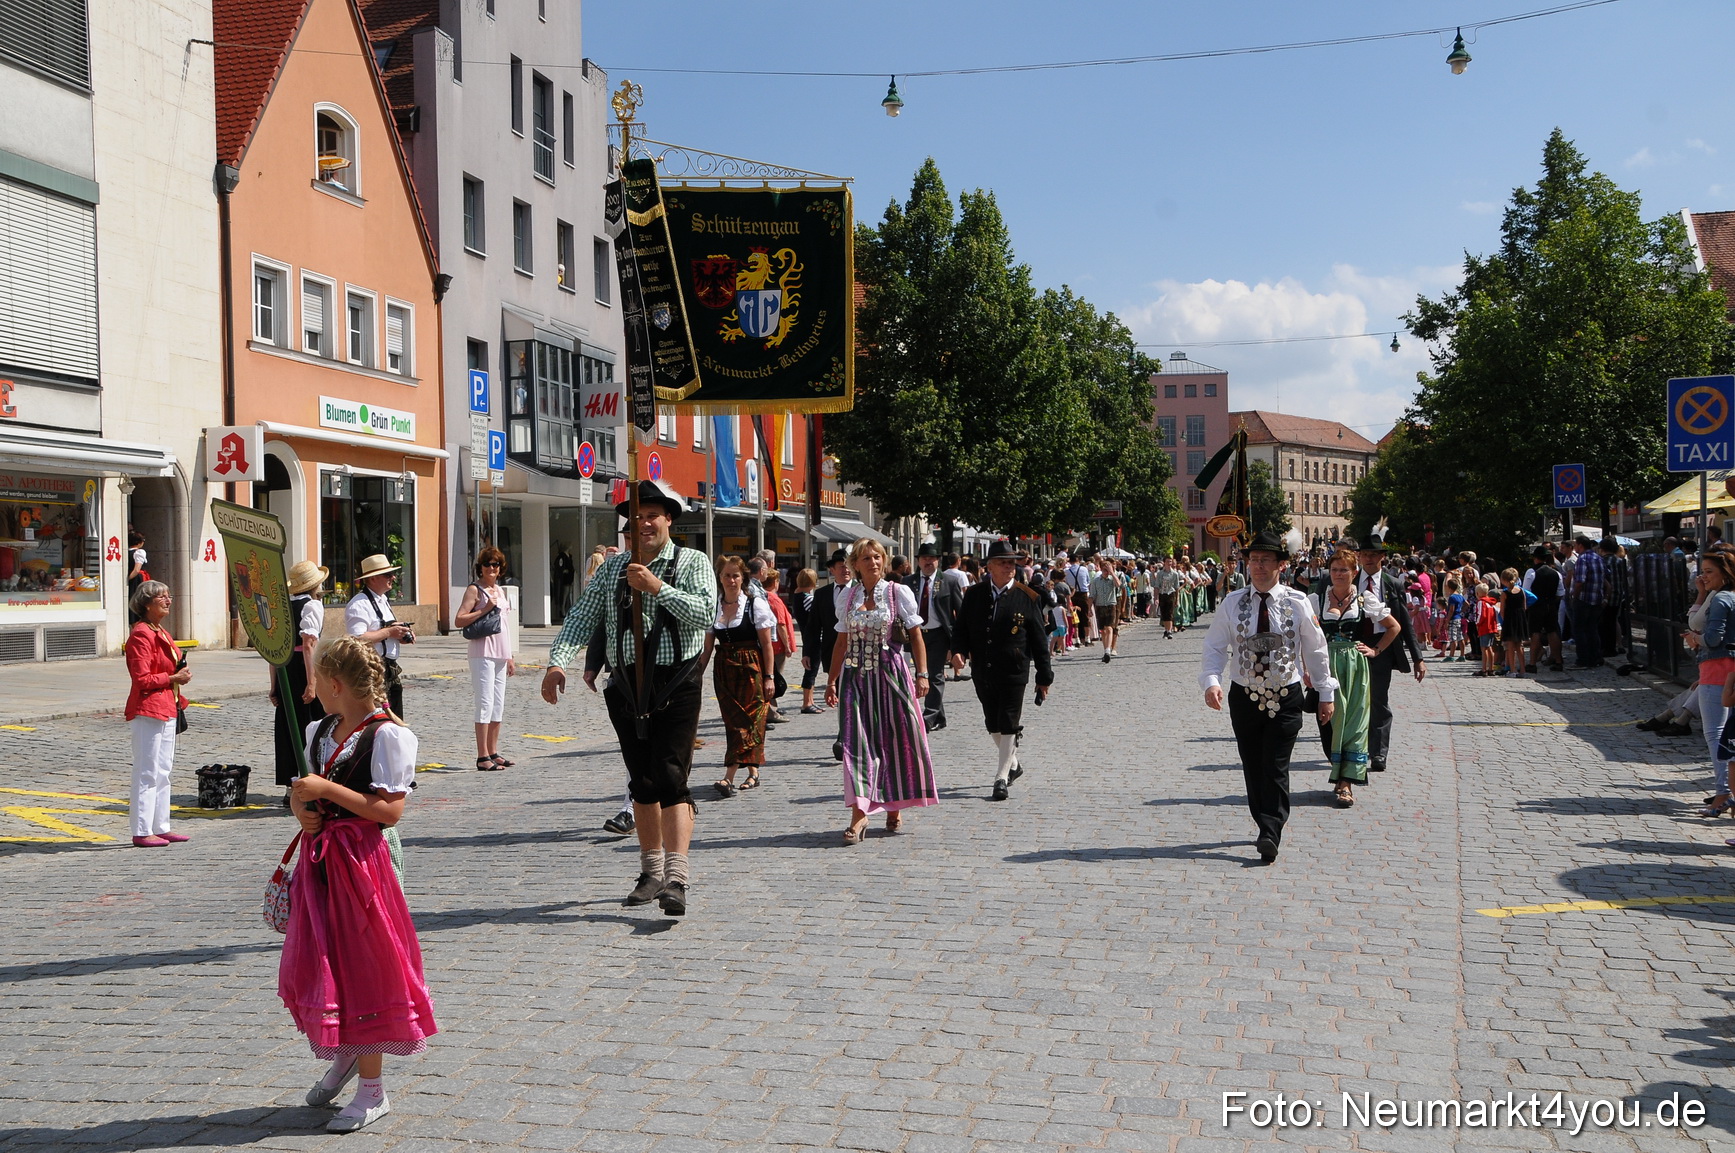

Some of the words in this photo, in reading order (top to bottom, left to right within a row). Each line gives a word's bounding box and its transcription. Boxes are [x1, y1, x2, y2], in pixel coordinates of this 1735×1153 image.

[691, 212, 800, 240] Schützengau
[473, 375, 484, 407] P
[584, 392, 619, 418] H&M
[325, 403, 357, 425] Blumen
[371, 411, 388, 431] Grün
[391, 415, 411, 434] Punkt
[492, 435, 502, 465] P
[1673, 442, 1728, 463] TAXI
[19, 476, 76, 493] APOTHEKE
[1557, 494, 1582, 505] TAXI
[218, 511, 277, 540] SCHÜTZENGAU
